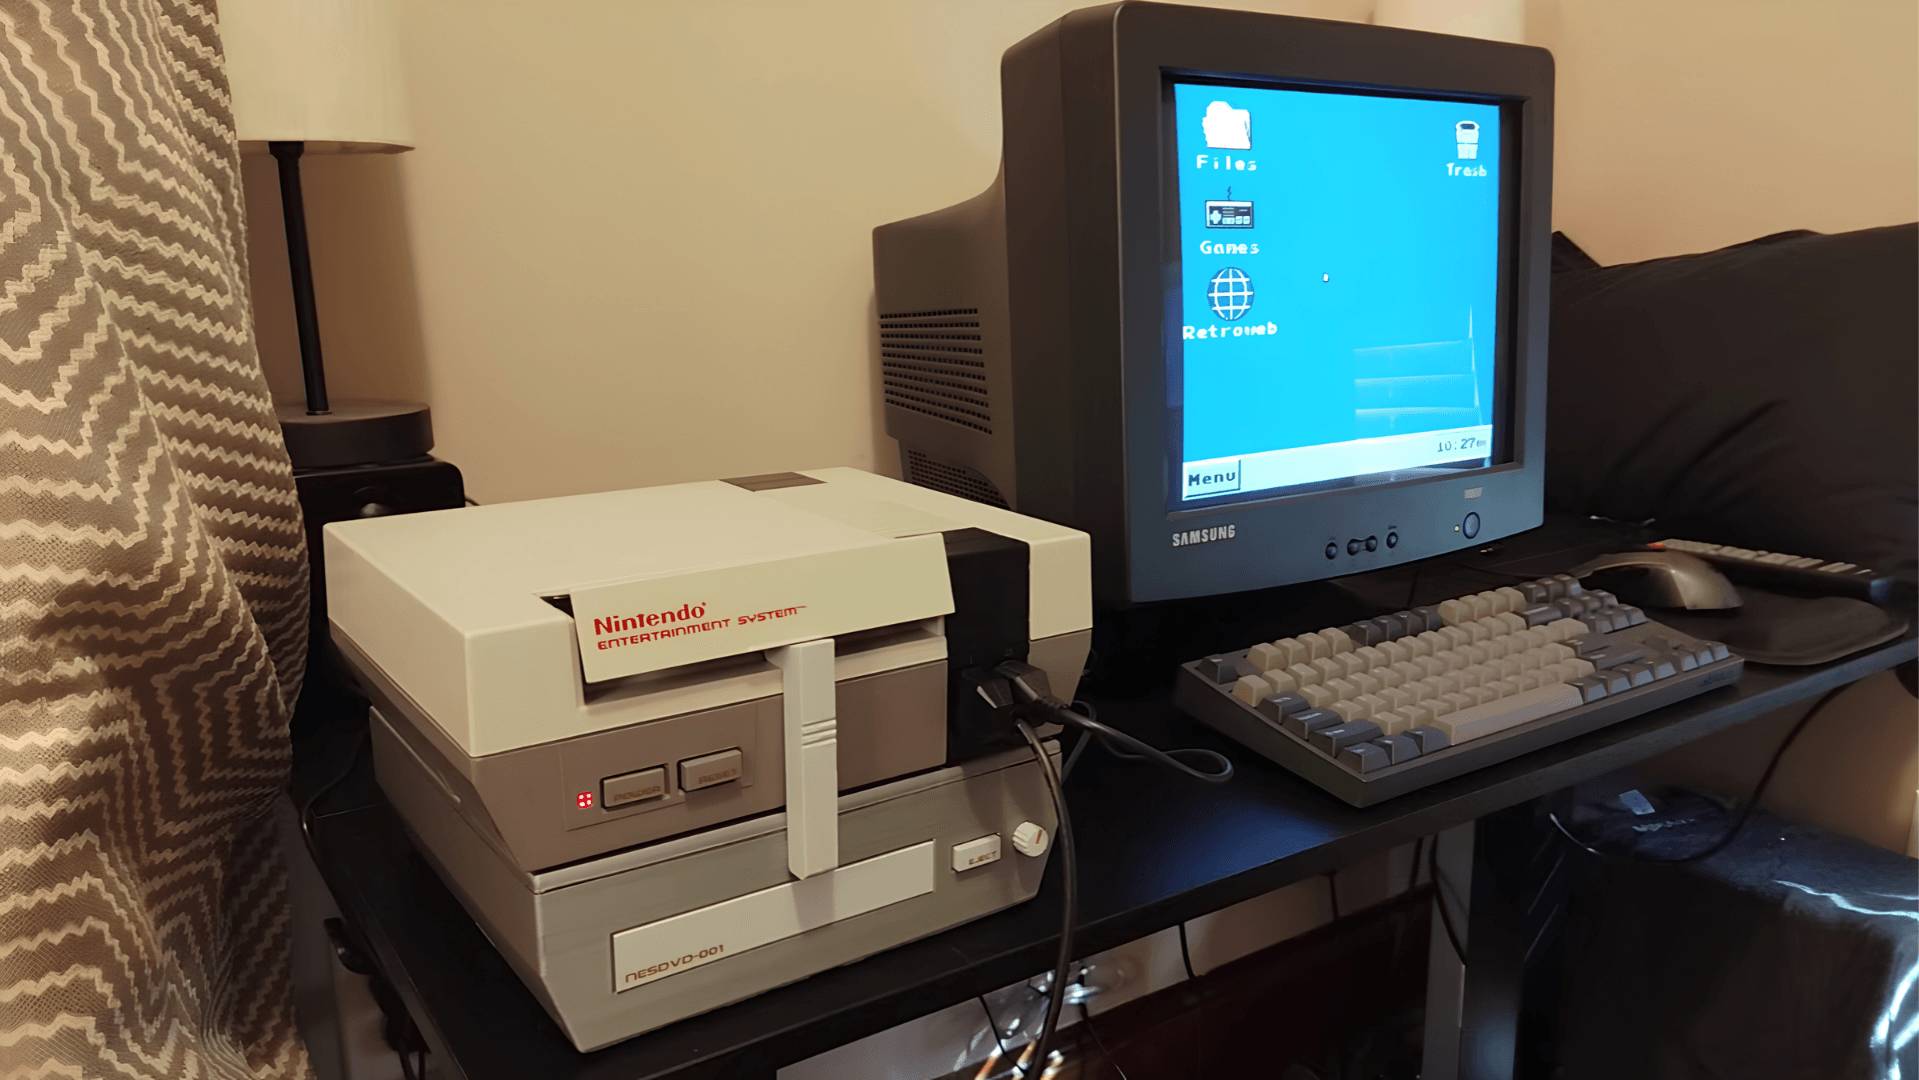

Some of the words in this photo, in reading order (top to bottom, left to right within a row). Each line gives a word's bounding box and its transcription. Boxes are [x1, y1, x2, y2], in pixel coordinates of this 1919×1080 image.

[1197, 155, 1257, 171] Files
[1446, 163, 1487, 177] Trash
[1200, 240, 1259, 255] Games
[1183, 322, 1278, 340] Retroweb
[1437, 437, 1476, 453] 10:27
[1188, 470, 1236, 487] Menu
[1172, 525, 1236, 547] SAMSUNG
[594, 603, 704, 635] Nintendo
[597, 619, 731, 650] ENTERTAINMENT
